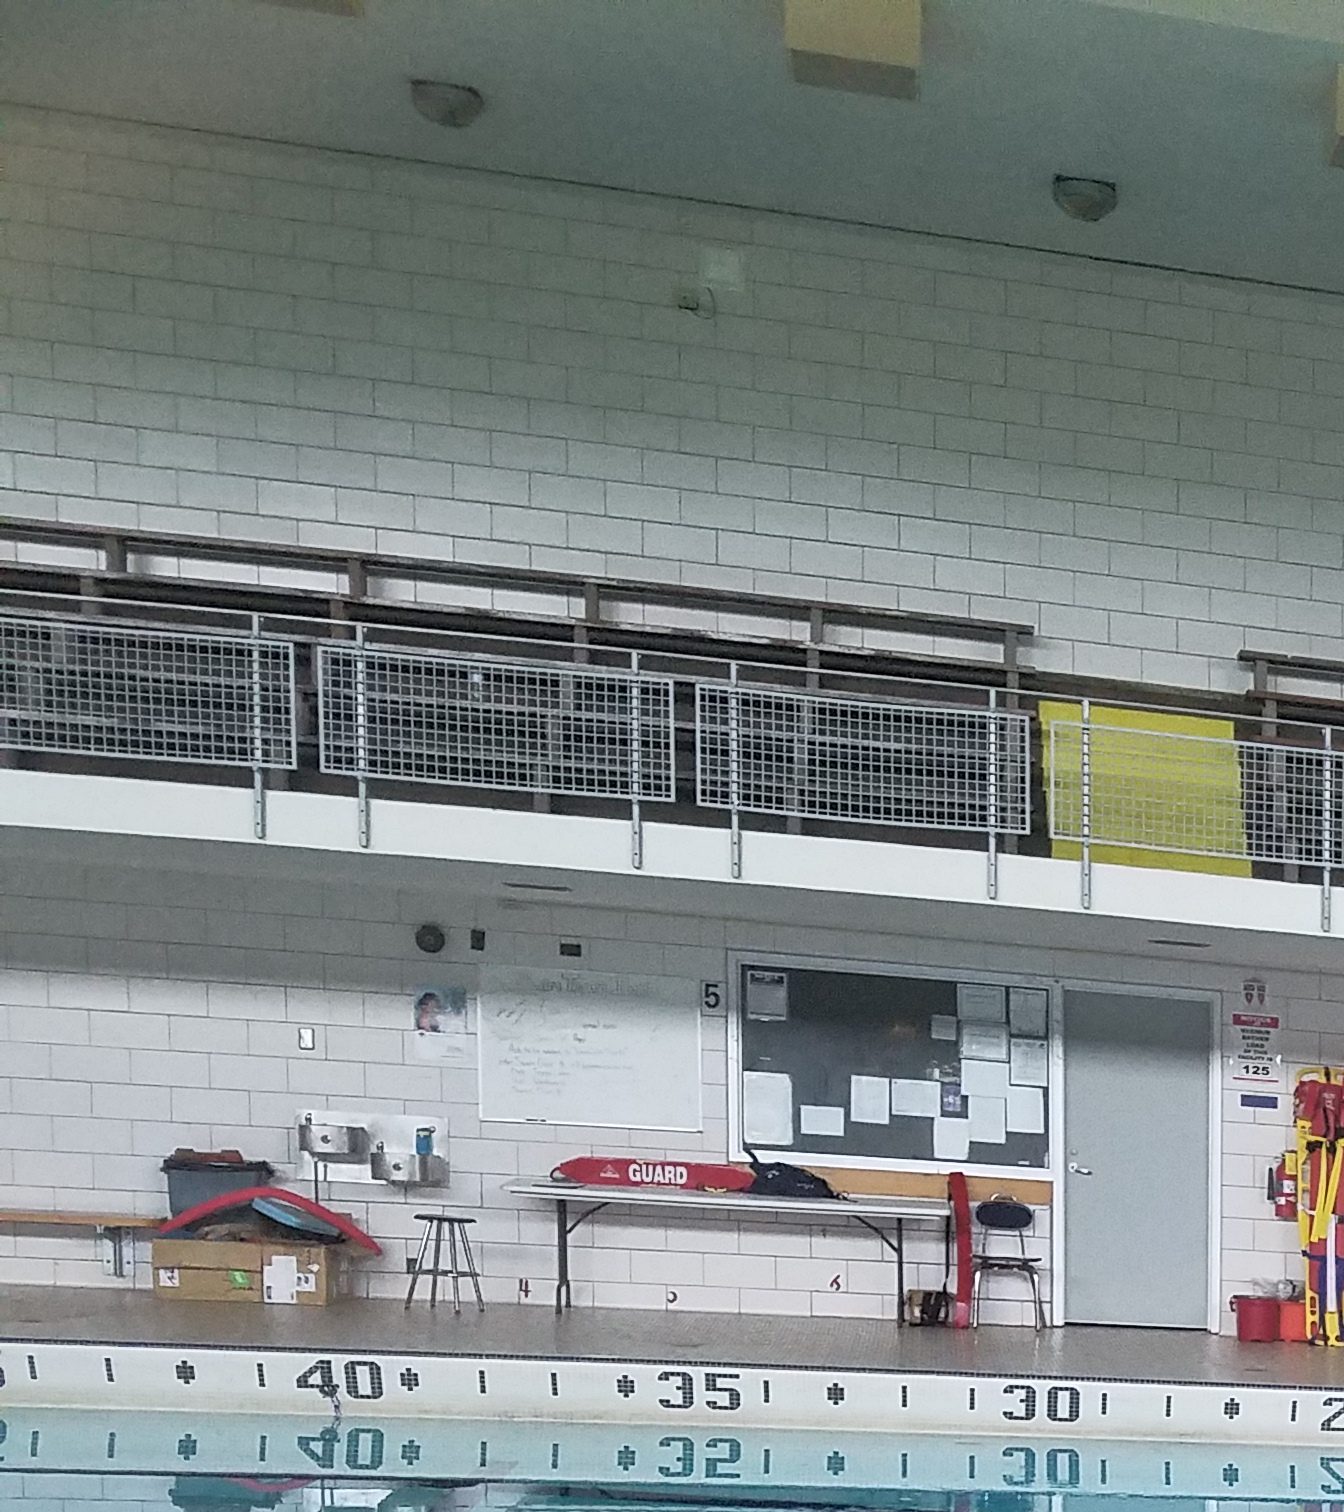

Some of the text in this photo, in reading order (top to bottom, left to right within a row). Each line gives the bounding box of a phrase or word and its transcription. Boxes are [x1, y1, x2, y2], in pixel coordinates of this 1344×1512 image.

[704, 982, 721, 1009] 5
[1242, 1064, 1270, 1076] 125
[627, 1163, 688, 1185] GUARD
[296, 1358, 383, 1400] 40
[656, 1370, 742, 1411] 35
[1001, 1384, 1081, 1424] 30
